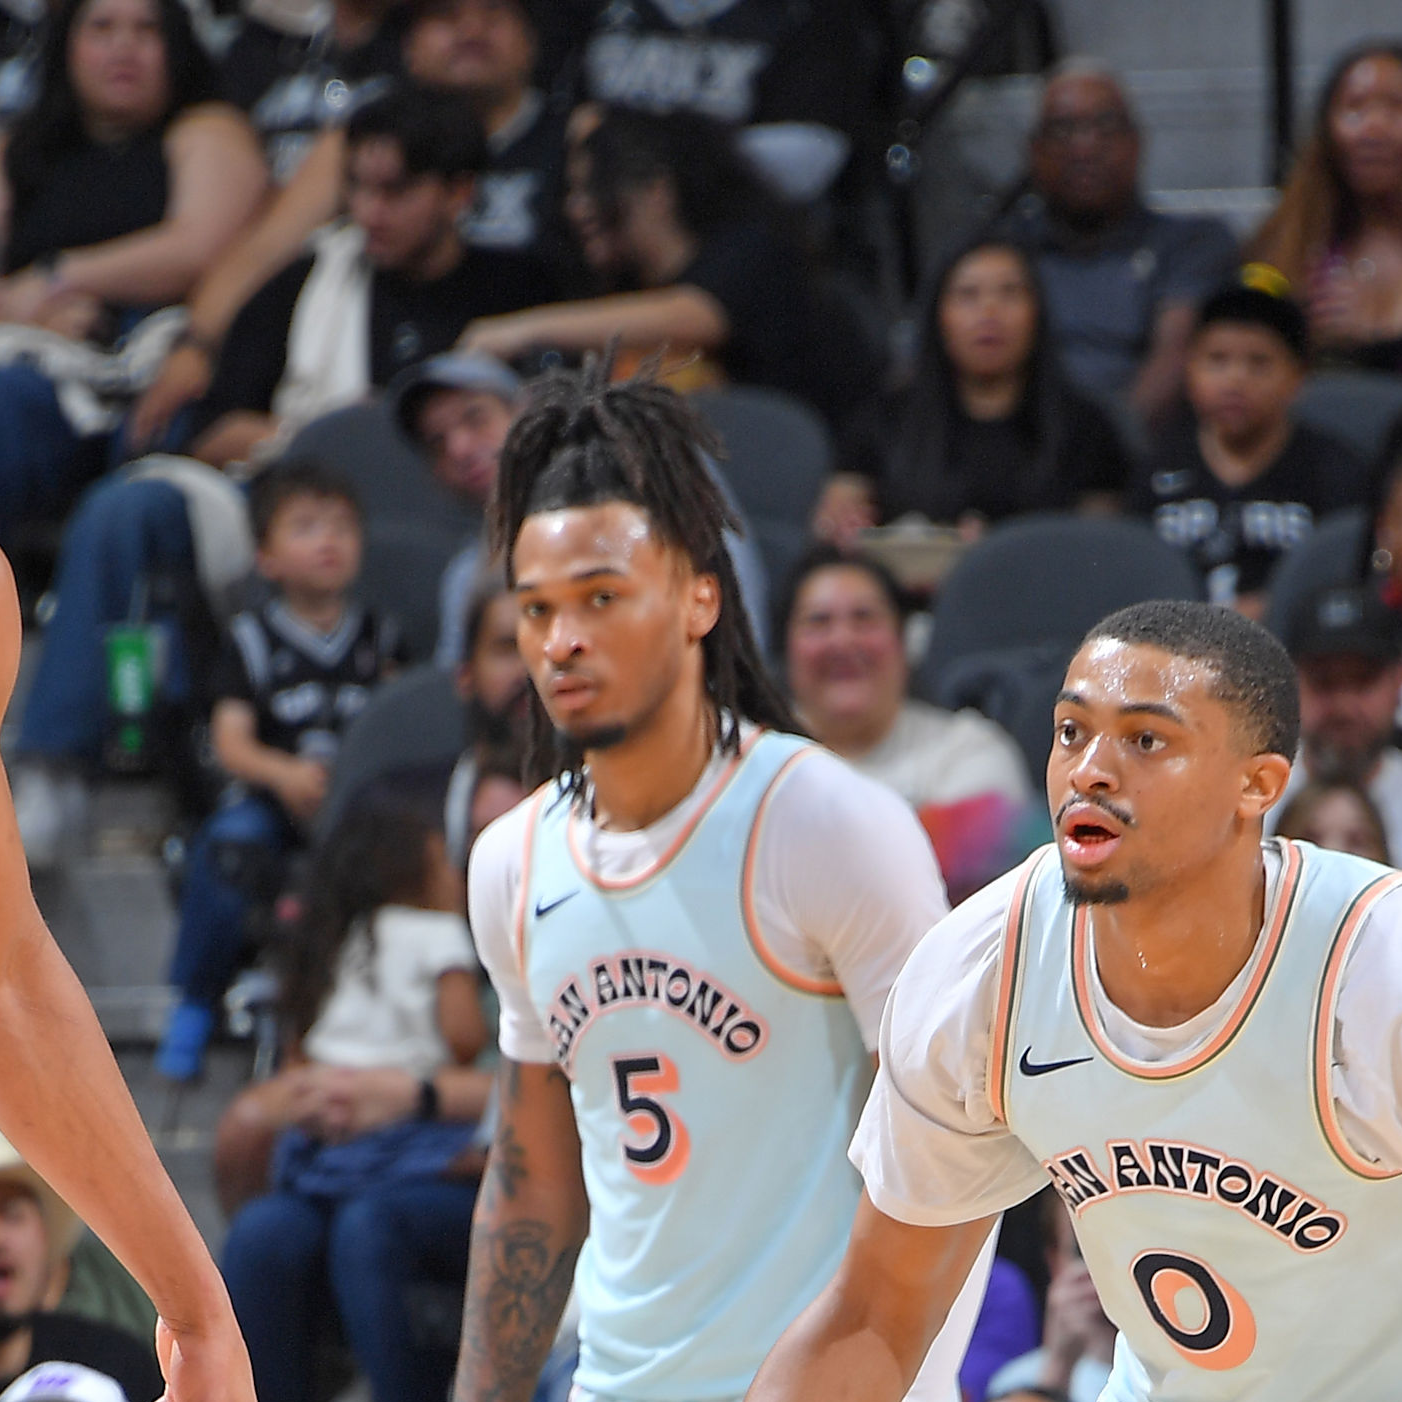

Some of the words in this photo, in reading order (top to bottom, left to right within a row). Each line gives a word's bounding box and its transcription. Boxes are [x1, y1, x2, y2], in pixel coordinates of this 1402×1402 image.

[549, 981, 590, 1072] AN
[592, 955, 764, 1057] ANTONIO
[613, 1056, 683, 1175] 5
[1046, 1150, 1110, 1216] AN
[1108, 1141, 1344, 1253] ANTONIO
[1130, 1250, 1246, 1363] 0
